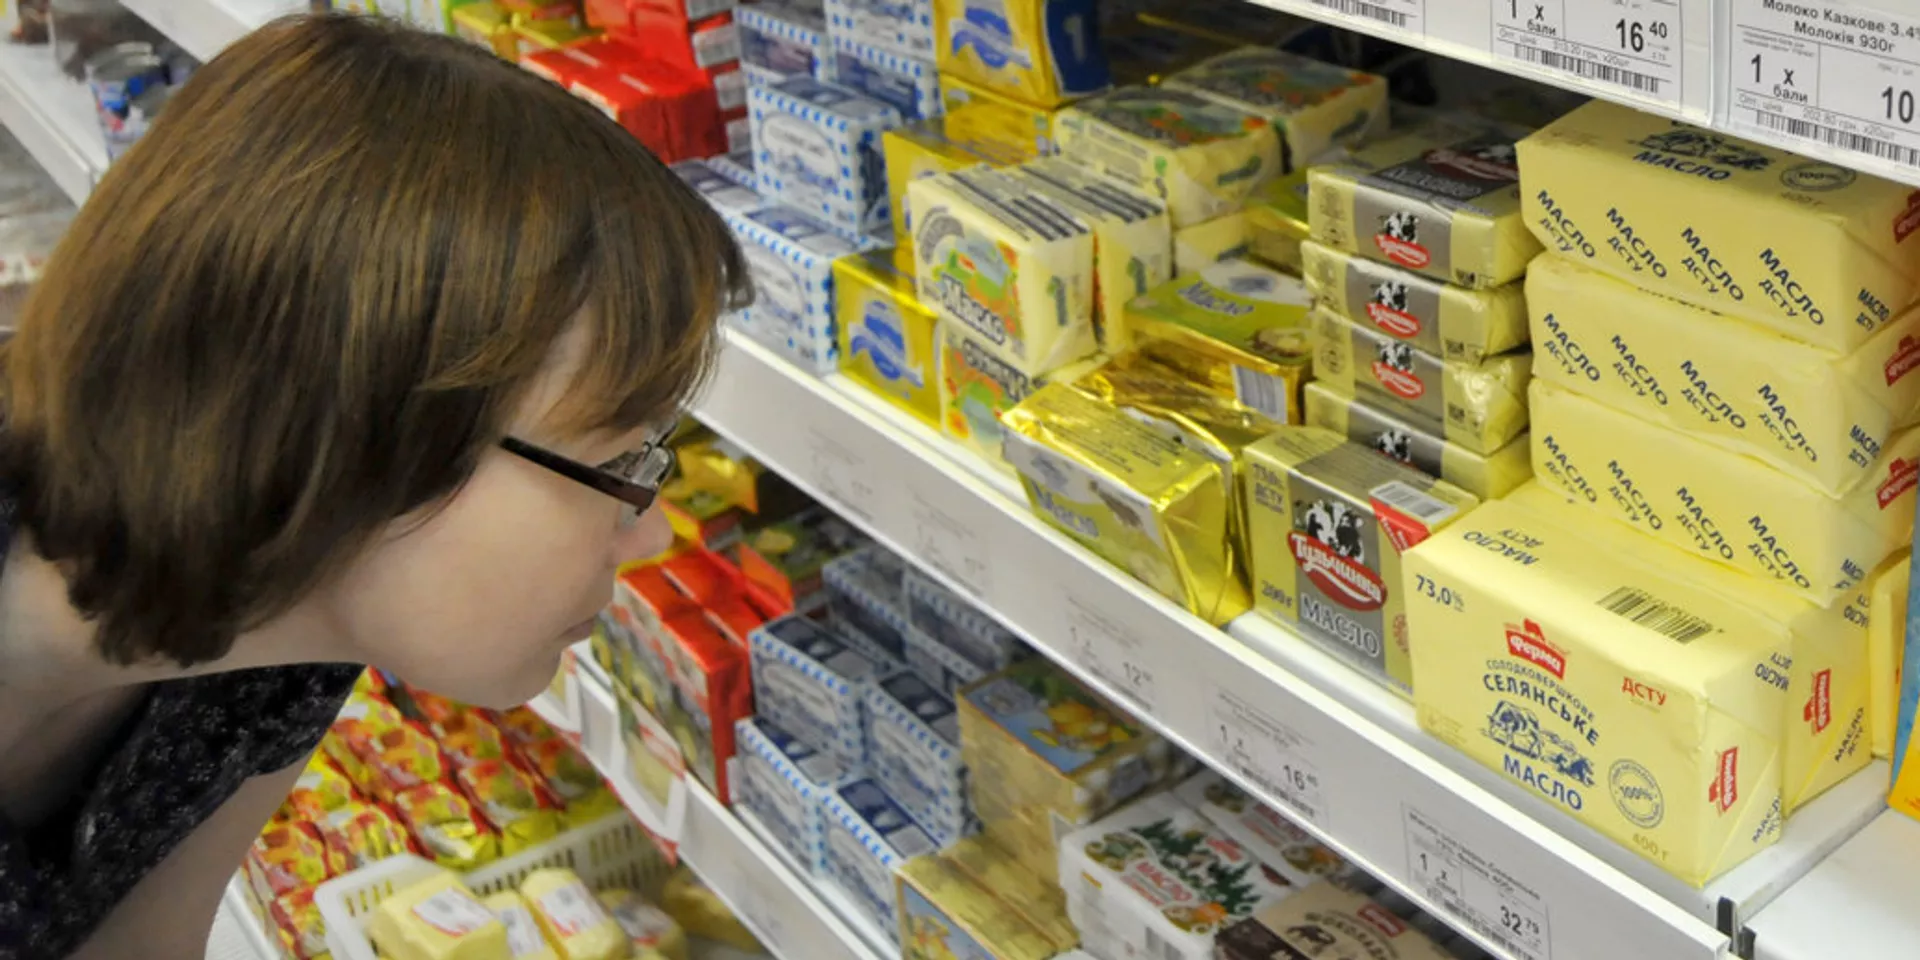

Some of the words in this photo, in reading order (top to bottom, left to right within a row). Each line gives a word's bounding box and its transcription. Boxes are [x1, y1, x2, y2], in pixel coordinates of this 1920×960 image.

[1527, 18, 1557, 36] бали
[1615, 18, 1644, 52] 16
[1649, 21, 1668, 39] 40
[1762, 0, 1819, 19] Молоко
[1823, 9, 1886, 33] Казкове
[1794, 20, 1855, 45] Молокія
[1859, 34, 1897, 53] 930г
[1751, 54, 1762, 83] 1
[1773, 84, 1808, 104] бали
[1881, 86, 1915, 124] 10
[1632, 150, 1732, 182] МАСЛО
[1536, 189, 1596, 260] МАСЛО
[1539, 216, 1574, 254] ДСТУ
[1606, 207, 1668, 280] МАСЛО
[1607, 234, 1644, 274] ДСТУ
[1680, 226, 1745, 303] МАСЛО
[1681, 255, 1720, 295] ДСТУ
[1758, 247, 1825, 326] МАСЛО
[1758, 278, 1798, 319] ДСТУ
[1857, 287, 1890, 322] МАСЛО
[1543, 313, 1601, 383] МАСЛО
[1543, 338, 1577, 376] ДСТУ
[1610, 334, 1669, 406] МАСЛО
[1611, 360, 1648, 398] ДСТУ
[1679, 360, 1747, 431] МАСЛО
[1680, 386, 1720, 425] ДСТУ
[1757, 383, 1818, 463] МАСЛО
[1757, 411, 1795, 453] ДСТУ
[1543, 434, 1598, 504] МАСЛО
[1544, 460, 1578, 498] ДСТУ
[1607, 459, 1663, 532] МАСЛО
[1607, 484, 1641, 522] ДСТУ
[1676, 486, 1735, 561] МАСЛО
[1676, 512, 1711, 551] ДСТУ
[1463, 530, 1540, 565] МАСЛО
[1747, 515, 1811, 590] МАСЛО
[1747, 542, 1788, 580] ДСТУ
[1300, 594, 1381, 659] МАСЛО
[1510, 635, 1562, 673] Ферма
[1123, 661, 1142, 686] 12
[1486, 659, 1595, 721] СОЛОДКОВЕРШКОВЕ
[1621, 676, 1667, 706] ДСТУ
[1754, 662, 1790, 693] МАСЛО
[1483, 673, 1600, 747] СЕЛЯНСЬКЕ
[1283, 764, 1305, 790] 16
[1503, 753, 1583, 811] МАСЛО
[1420, 853, 1428, 872] 1
[1632, 833, 1658, 856] 400
[1500, 904, 1522, 936] 32
